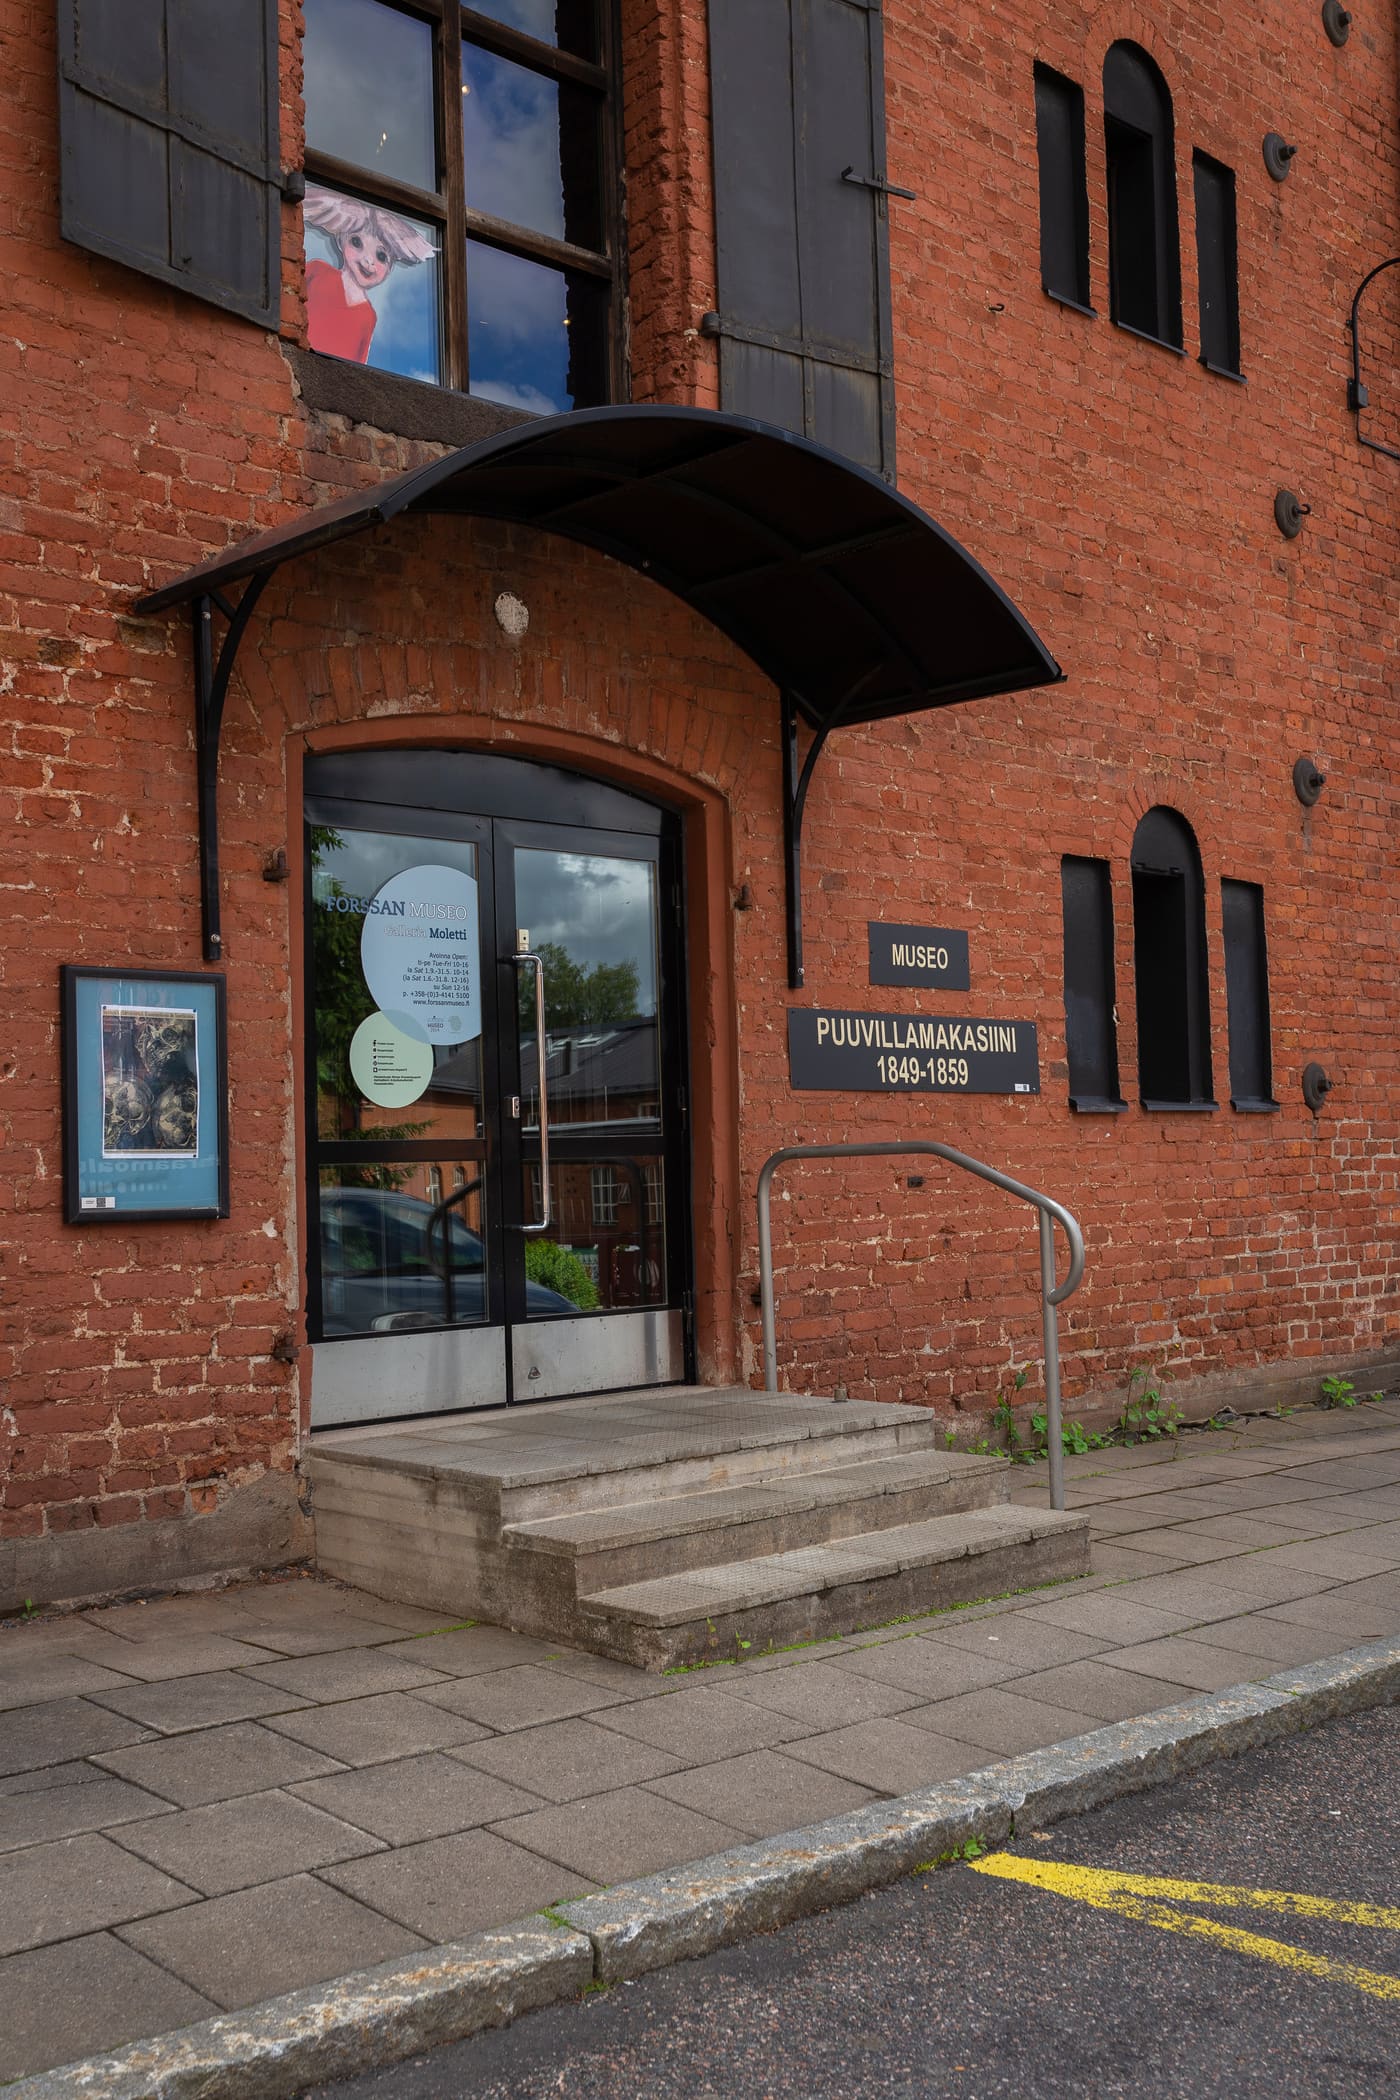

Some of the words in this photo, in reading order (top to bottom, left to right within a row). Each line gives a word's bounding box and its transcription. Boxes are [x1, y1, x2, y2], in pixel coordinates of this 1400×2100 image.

[326, 896, 405, 916] FORSSAN
[409, 902, 467, 921] MUSEO
[429, 927, 467, 940] Moletti
[429, 952, 451, 960] Avoinna
[891, 943, 948, 970] MUSEO
[816, 1017, 1017, 1053] PUUVILLAMAKASIINI
[877, 1055, 969, 1085] 1849-1859
